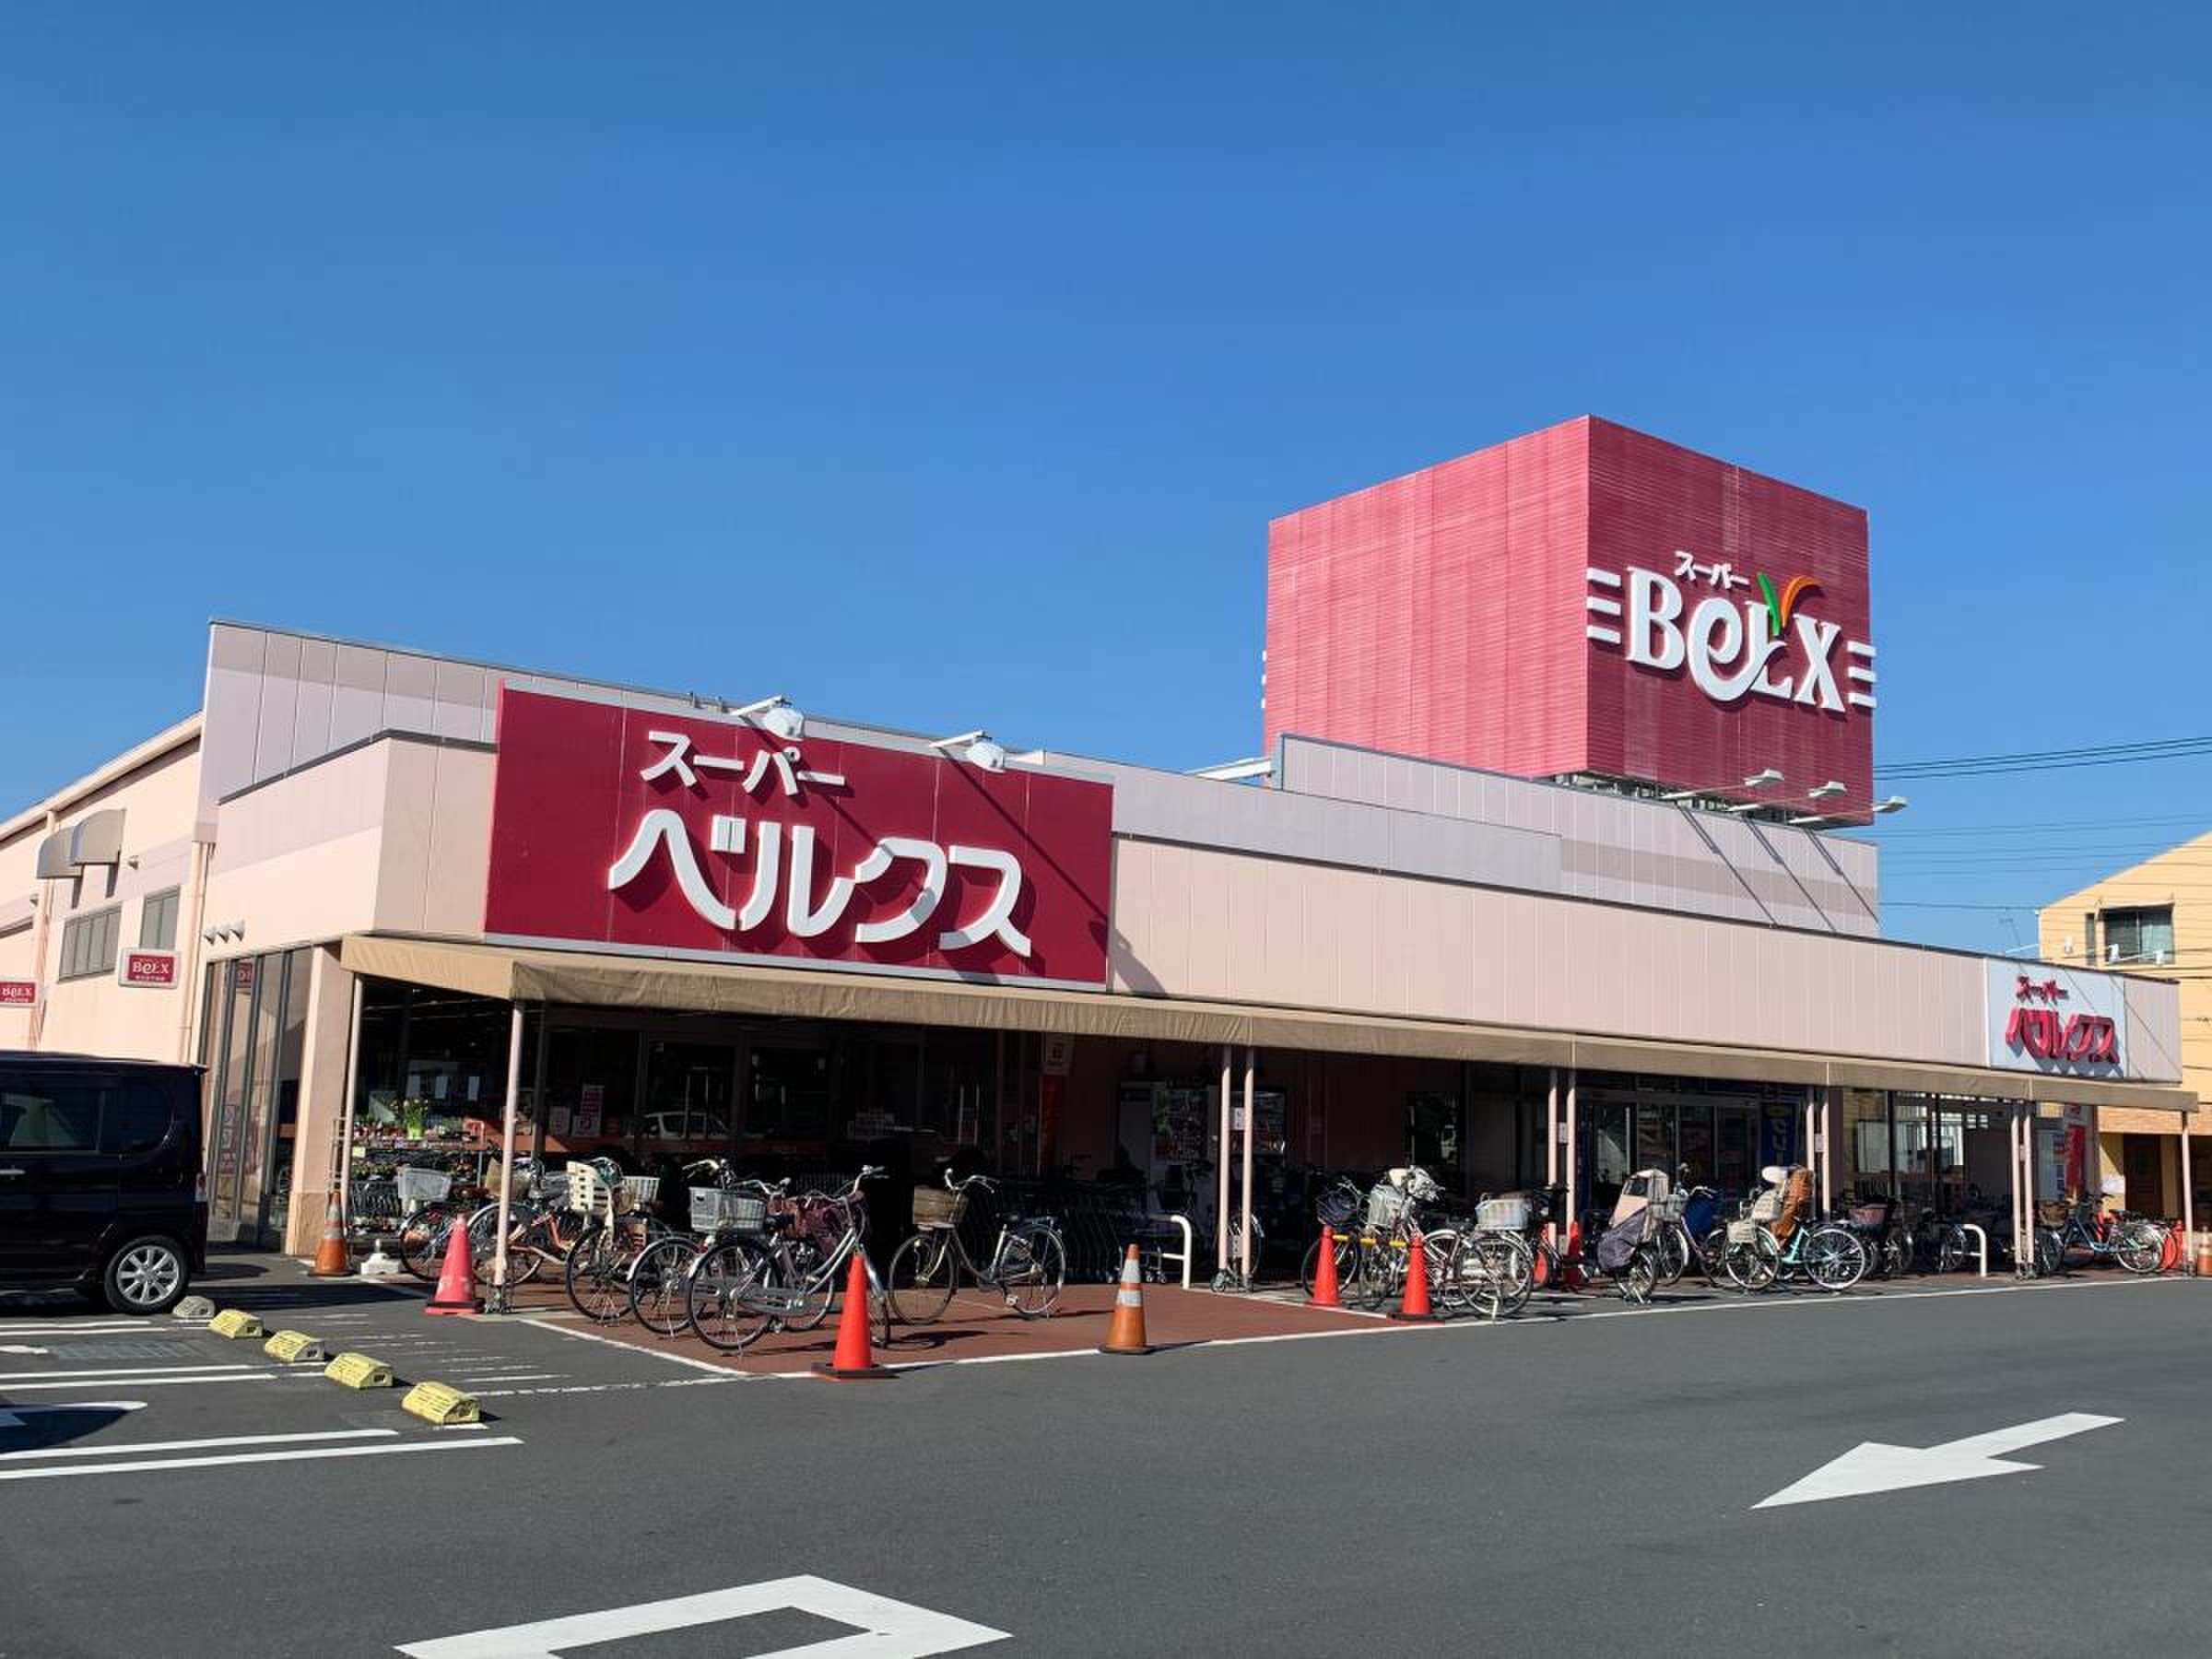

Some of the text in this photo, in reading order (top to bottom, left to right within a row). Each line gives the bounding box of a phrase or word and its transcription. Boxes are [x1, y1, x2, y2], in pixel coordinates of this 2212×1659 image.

[640, 730, 845, 795] スーパー
[607, 808, 1032, 959] ベルクス
